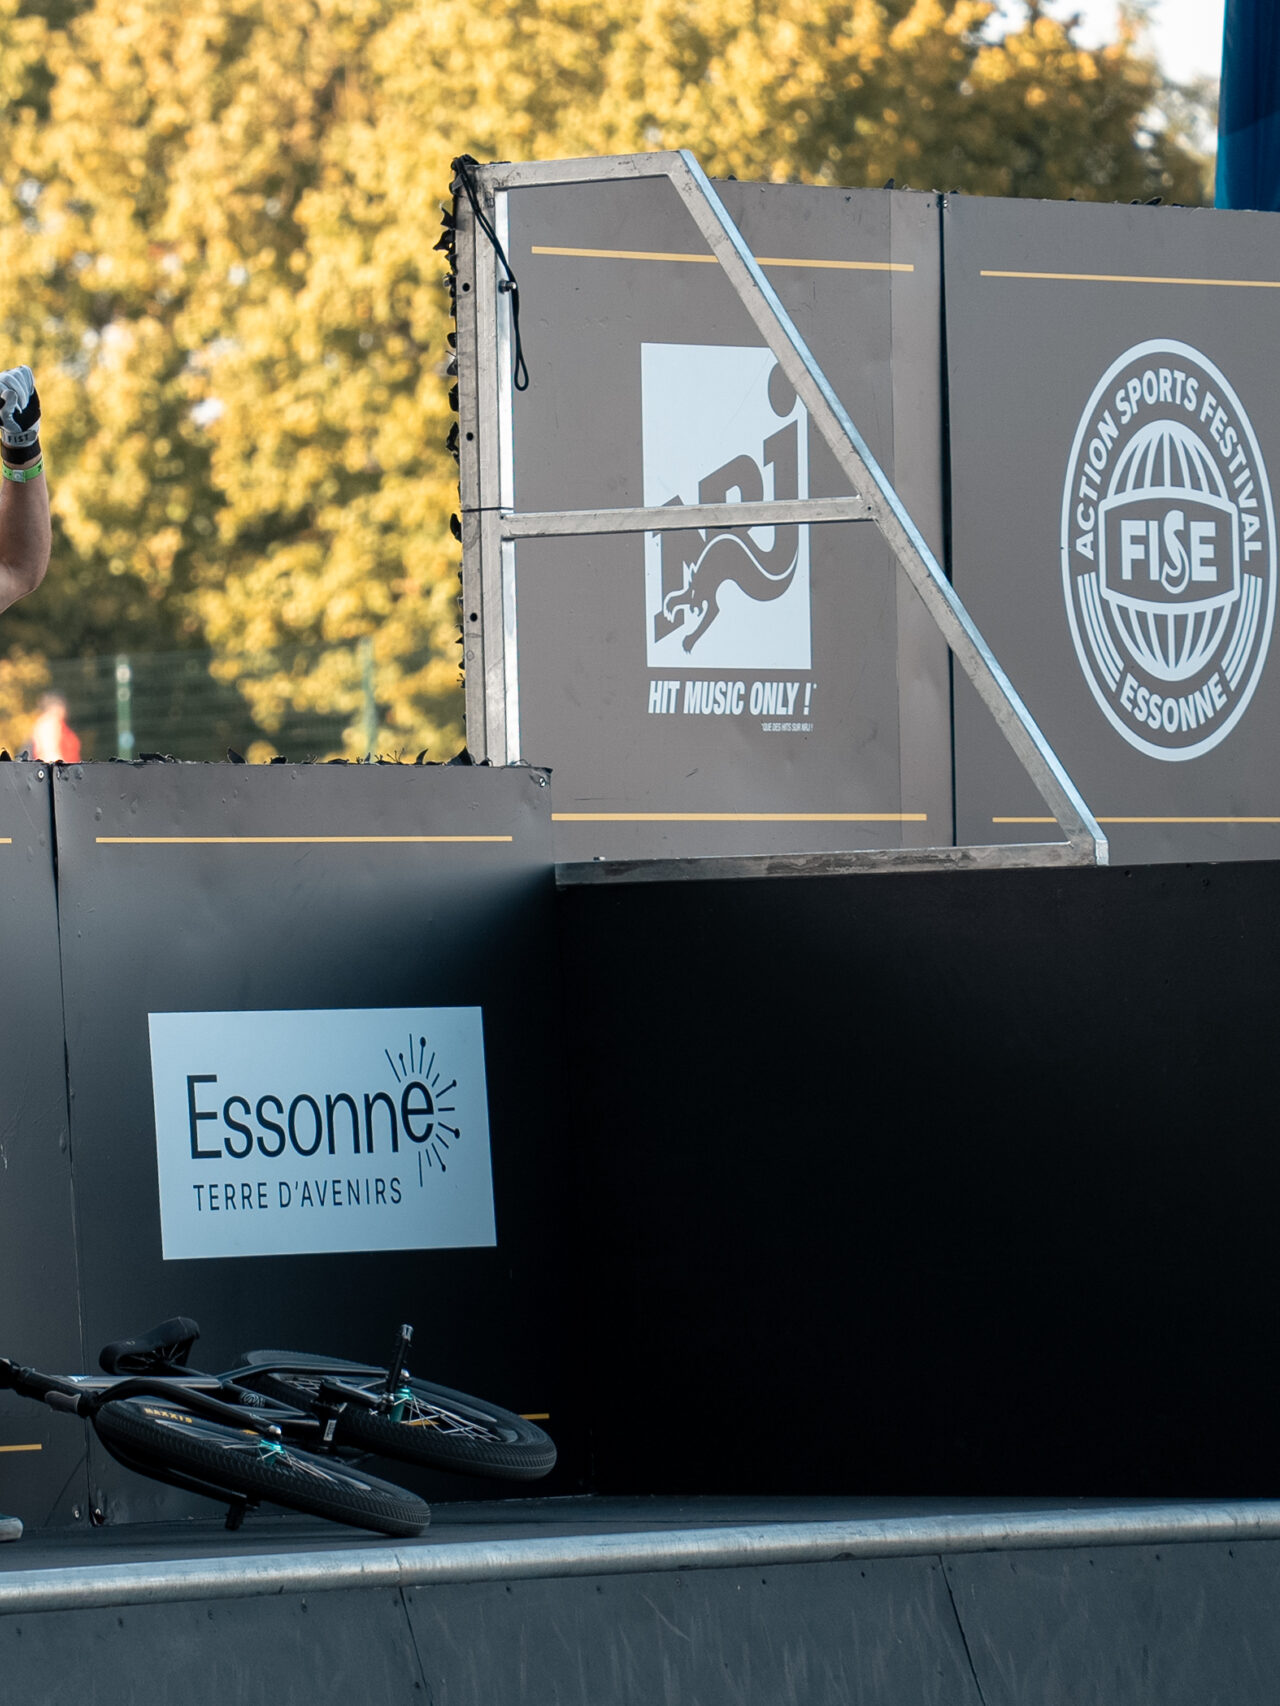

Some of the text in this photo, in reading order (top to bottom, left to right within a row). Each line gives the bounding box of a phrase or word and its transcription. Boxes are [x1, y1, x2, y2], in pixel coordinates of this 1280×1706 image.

[1075, 367, 1263, 562] ACTION SPORTS FESTIVAL
[1120, 509, 1218, 594] FISE
[648, 680, 681, 714] HIT
[683, 680, 746, 716] MUSIC
[749, 681, 801, 716] ONLY
[1120, 671, 1228, 733] ESSONNE
[186, 1073, 435, 1160] Essonne
[193, 1177, 403, 1212] TERRE D'AVENIRS
